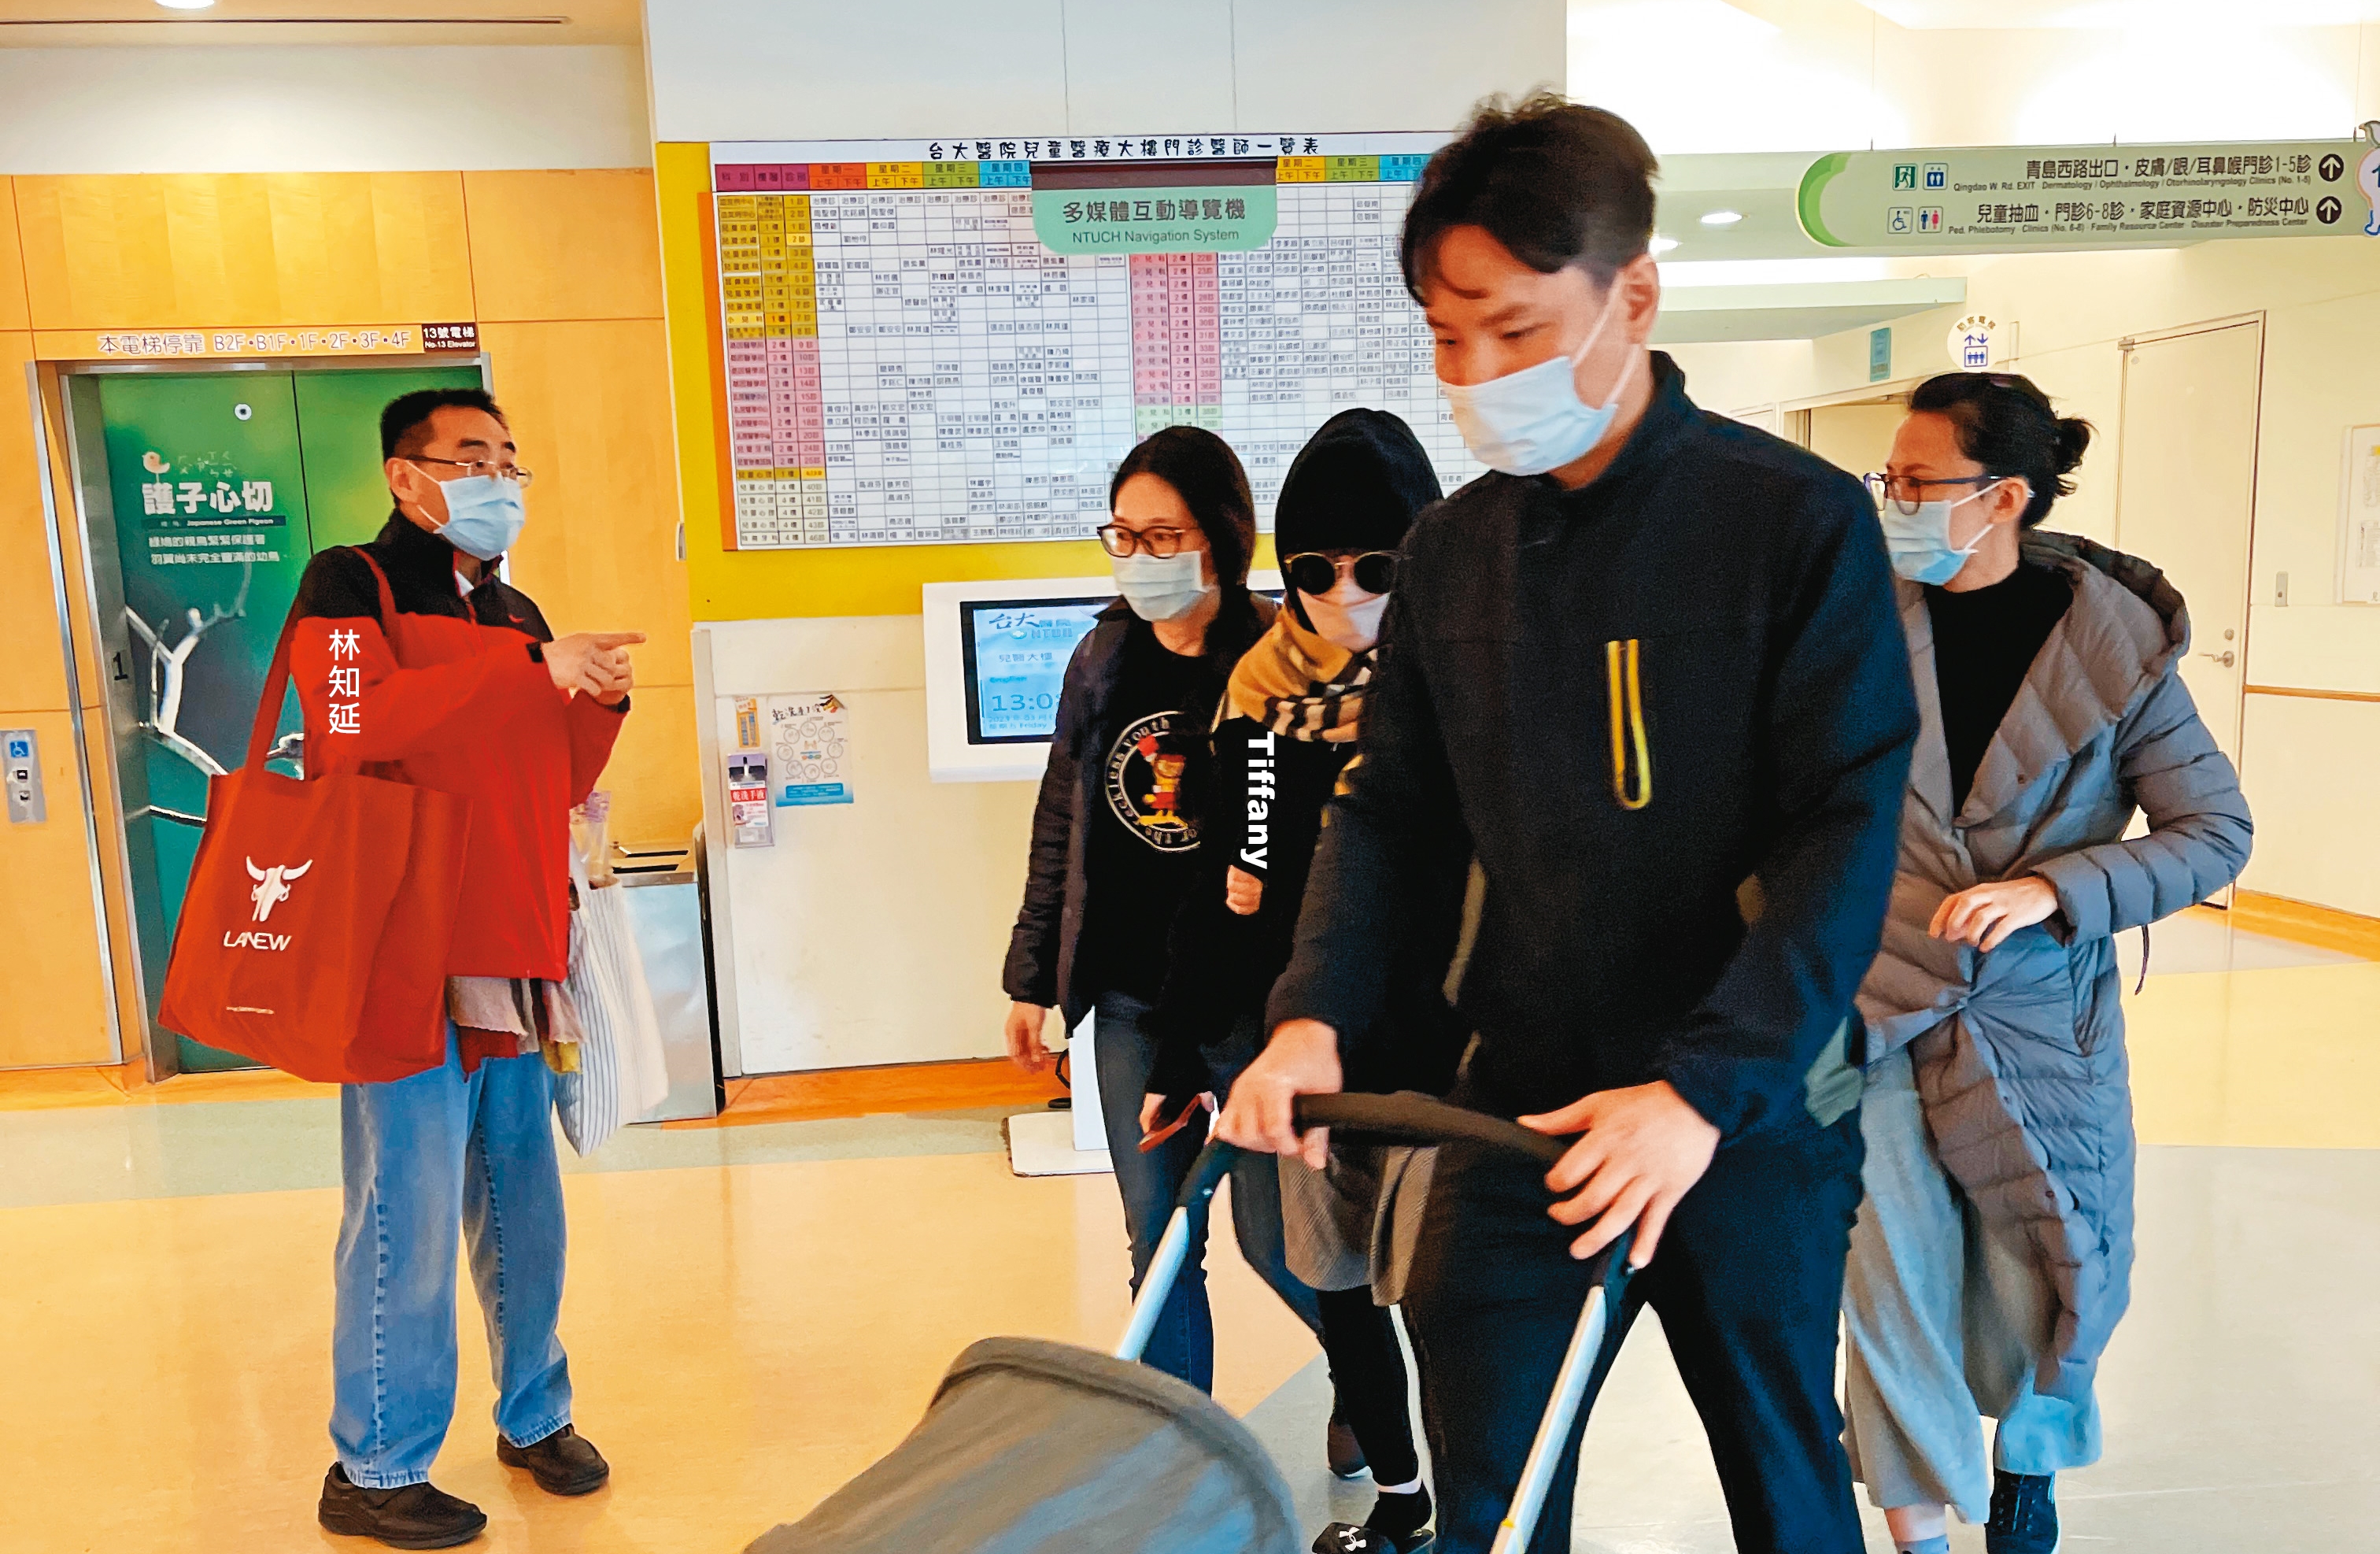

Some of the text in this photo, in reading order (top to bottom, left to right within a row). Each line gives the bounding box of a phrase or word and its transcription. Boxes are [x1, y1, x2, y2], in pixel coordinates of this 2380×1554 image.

[929, 137, 1319, 160] 台大醫院兒童醫療大樓門診醫師一覽表
[1953, 183, 1987, 193] Qingdao
[2017, 181, 2035, 190] EXIT
[2042, 180, 2093, 191] Dermatology
[2100, 179, 2159, 189] Ophthalmology
[2249, 176, 2275, 185] Clinics
[1062, 198, 1246, 224] 多媒體互動導覽機
[1073, 228, 1240, 244] NTUCH Navigation System
[1968, 225, 2015, 235] Phlebotomy
[2022, 224, 2049, 233] Clinics
[2091, 223, 2117, 232] Family
[2159, 221, 2185, 230] Center
[2190, 220, 2223, 229] Disaster
[423, 326, 475, 339] 13號電梯
[99, 334, 205, 354] 本電梯停靠
[142, 481, 273, 516] 護子心切
[113, 652, 129, 681] 1
